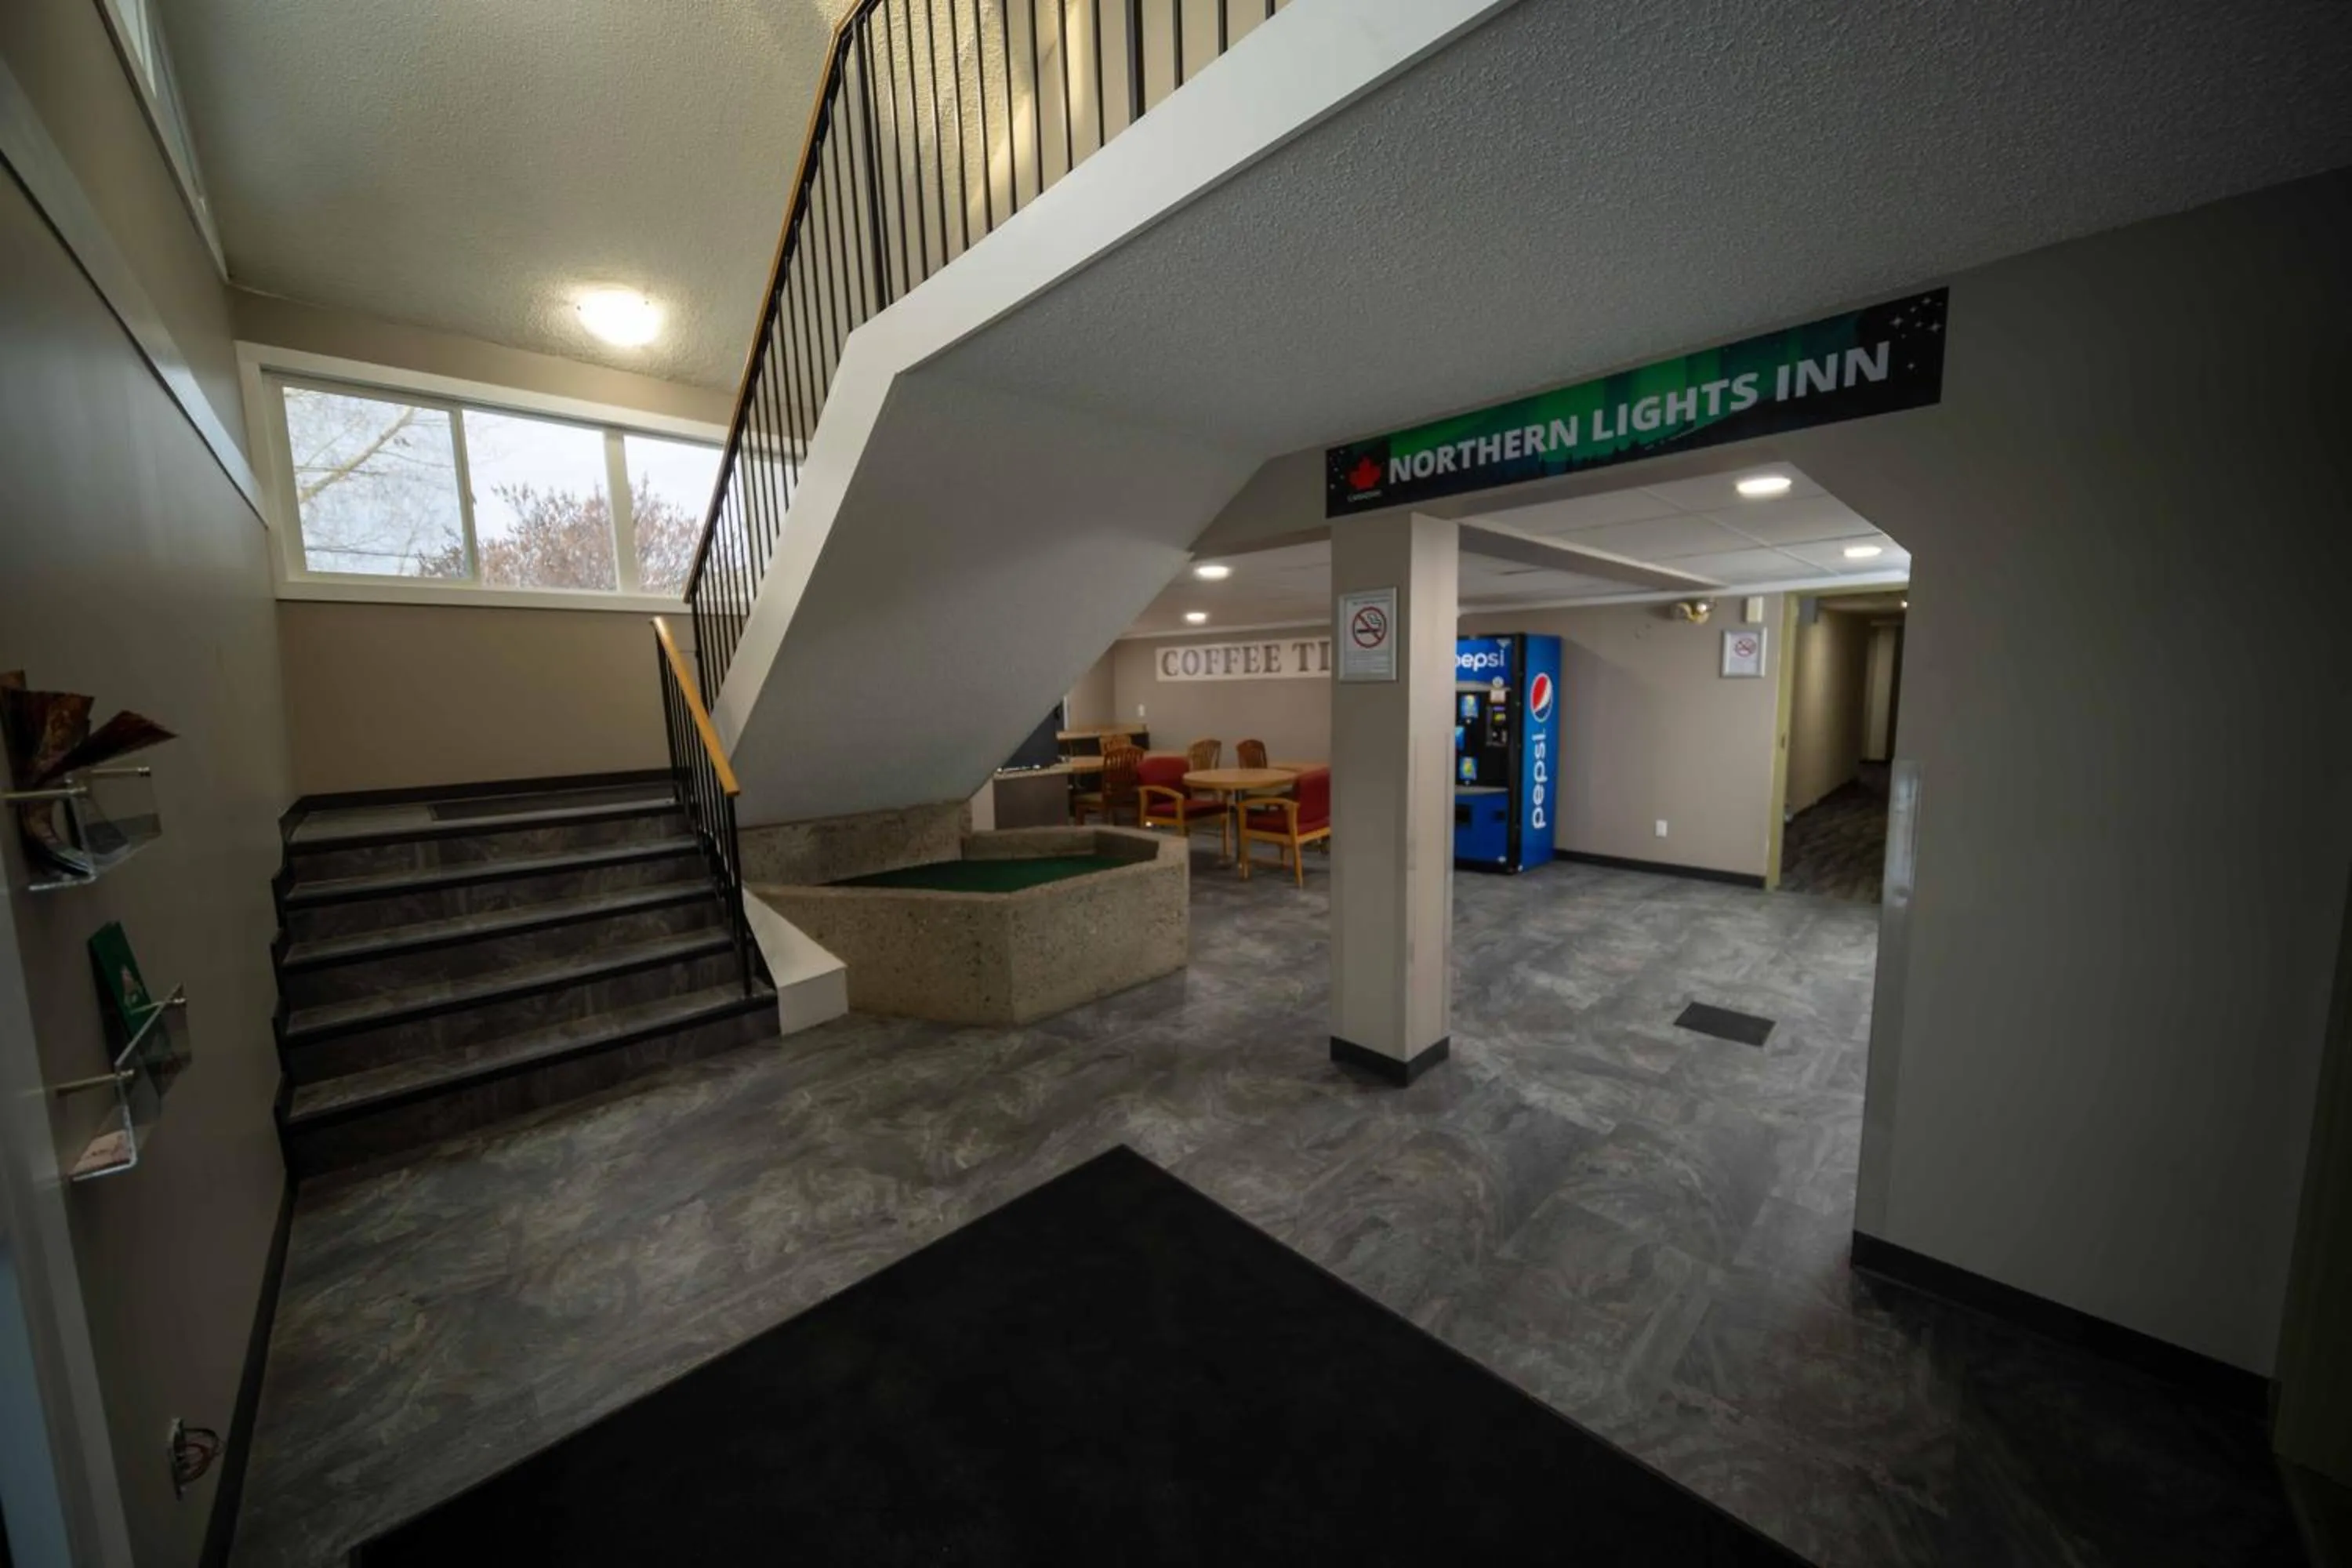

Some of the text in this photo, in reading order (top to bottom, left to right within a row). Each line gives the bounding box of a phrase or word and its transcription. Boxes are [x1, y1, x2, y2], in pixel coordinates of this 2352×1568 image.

[1388, 340, 1890, 485] NORTHERN LIGHTS INN
[1161, 644, 1282, 677] COFFEE
[1531, 728, 1548, 829] pepsi
